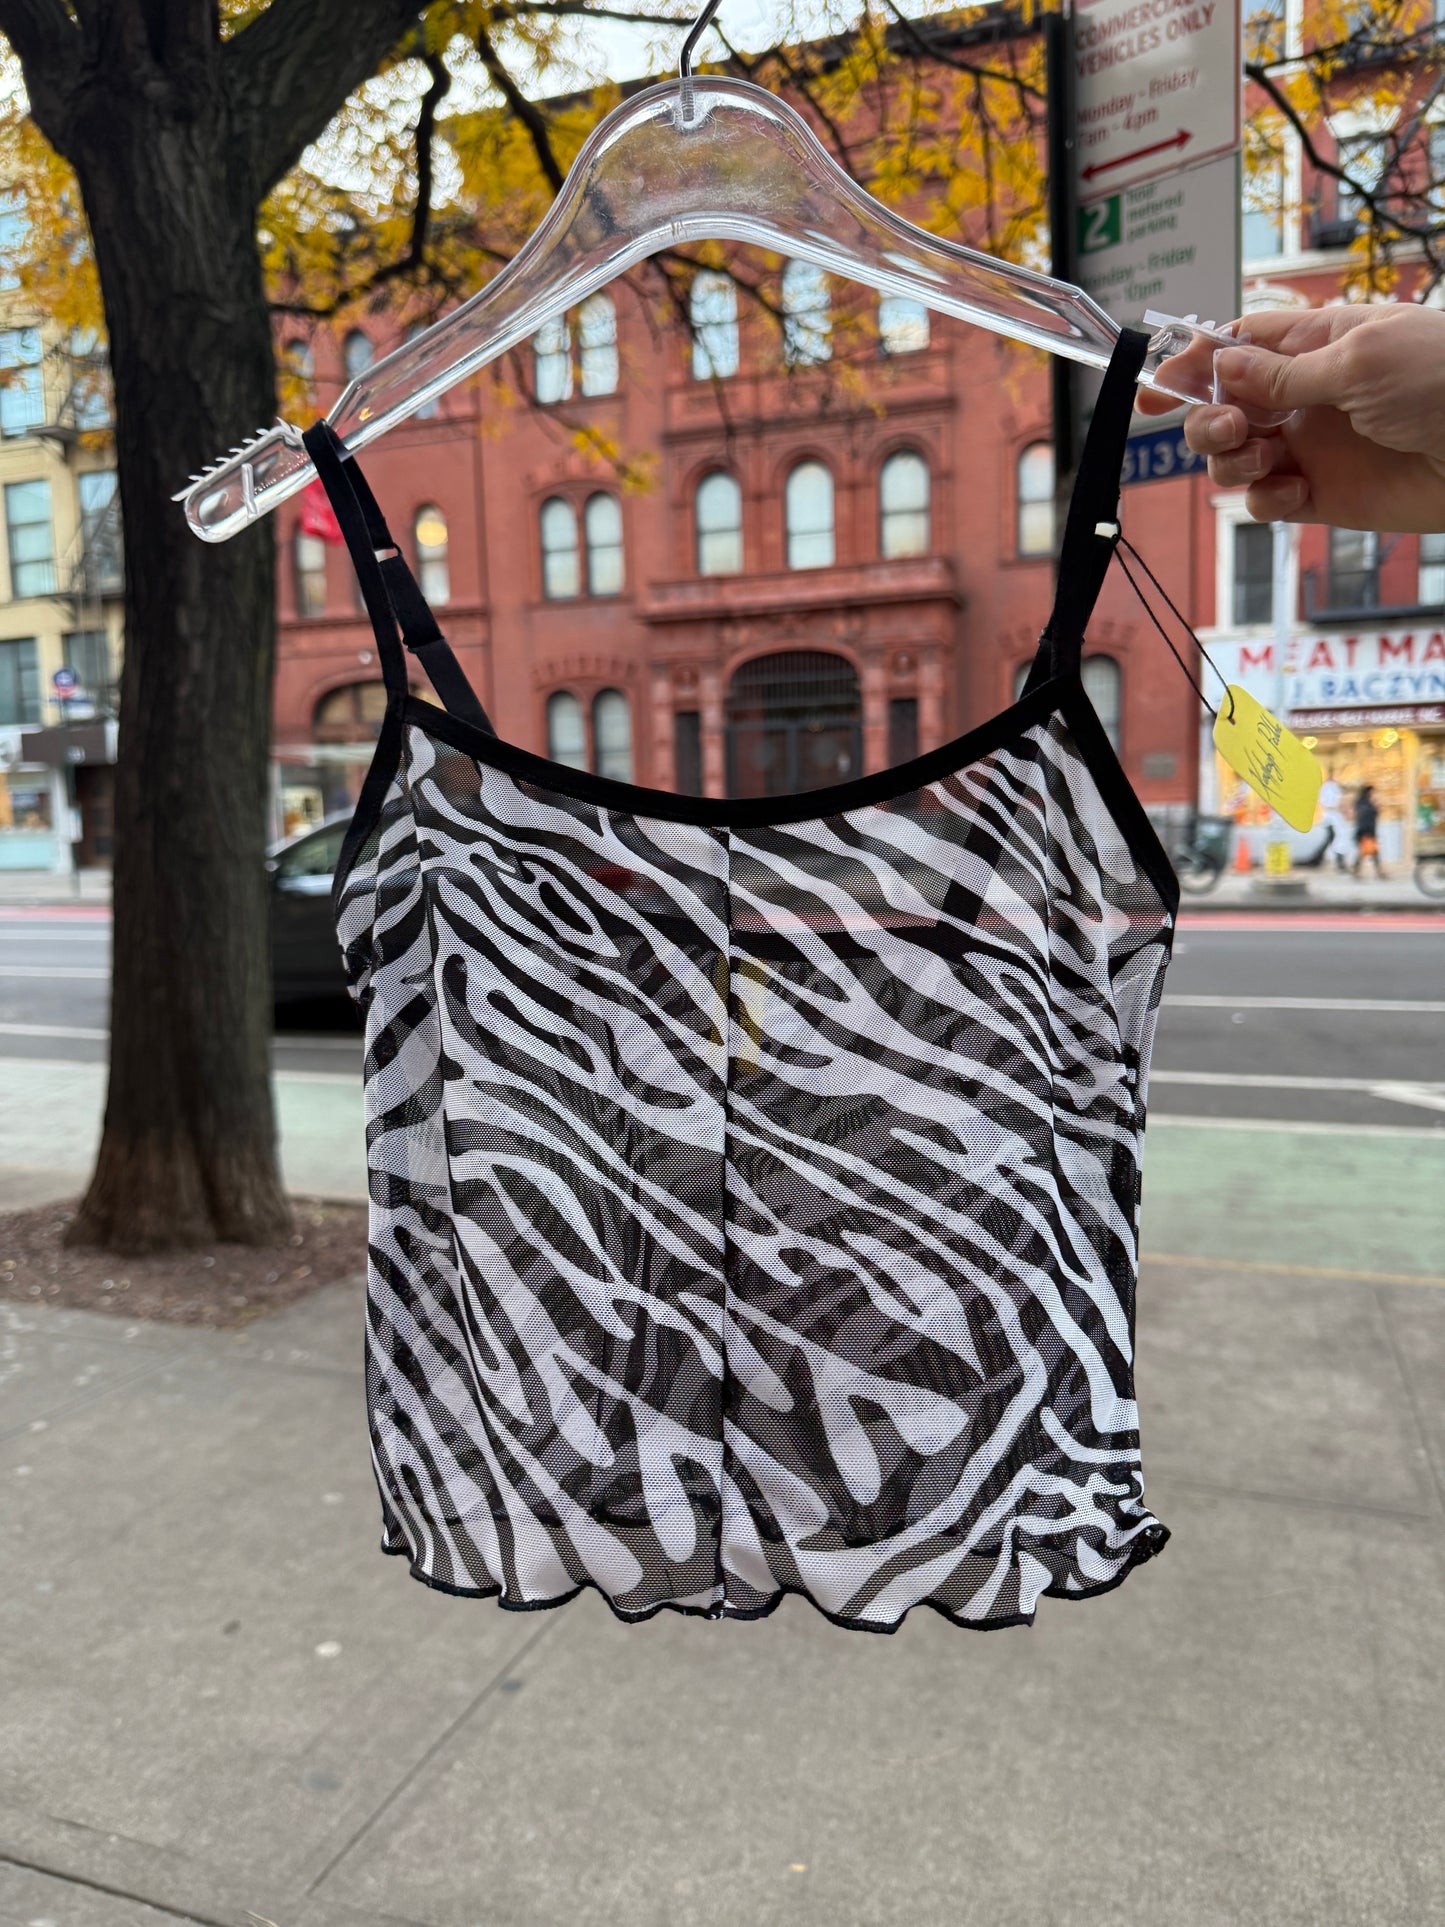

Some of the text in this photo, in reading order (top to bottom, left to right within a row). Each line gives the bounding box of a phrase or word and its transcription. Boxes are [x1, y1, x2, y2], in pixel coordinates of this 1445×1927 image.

[1077, 0, 1195, 50] COMMERCI
[1077, 1, 1216, 77] VEHICLES ONLY
[1083, 203, 1111, 250] 2
[1238, 637, 1358, 676] MEAT
